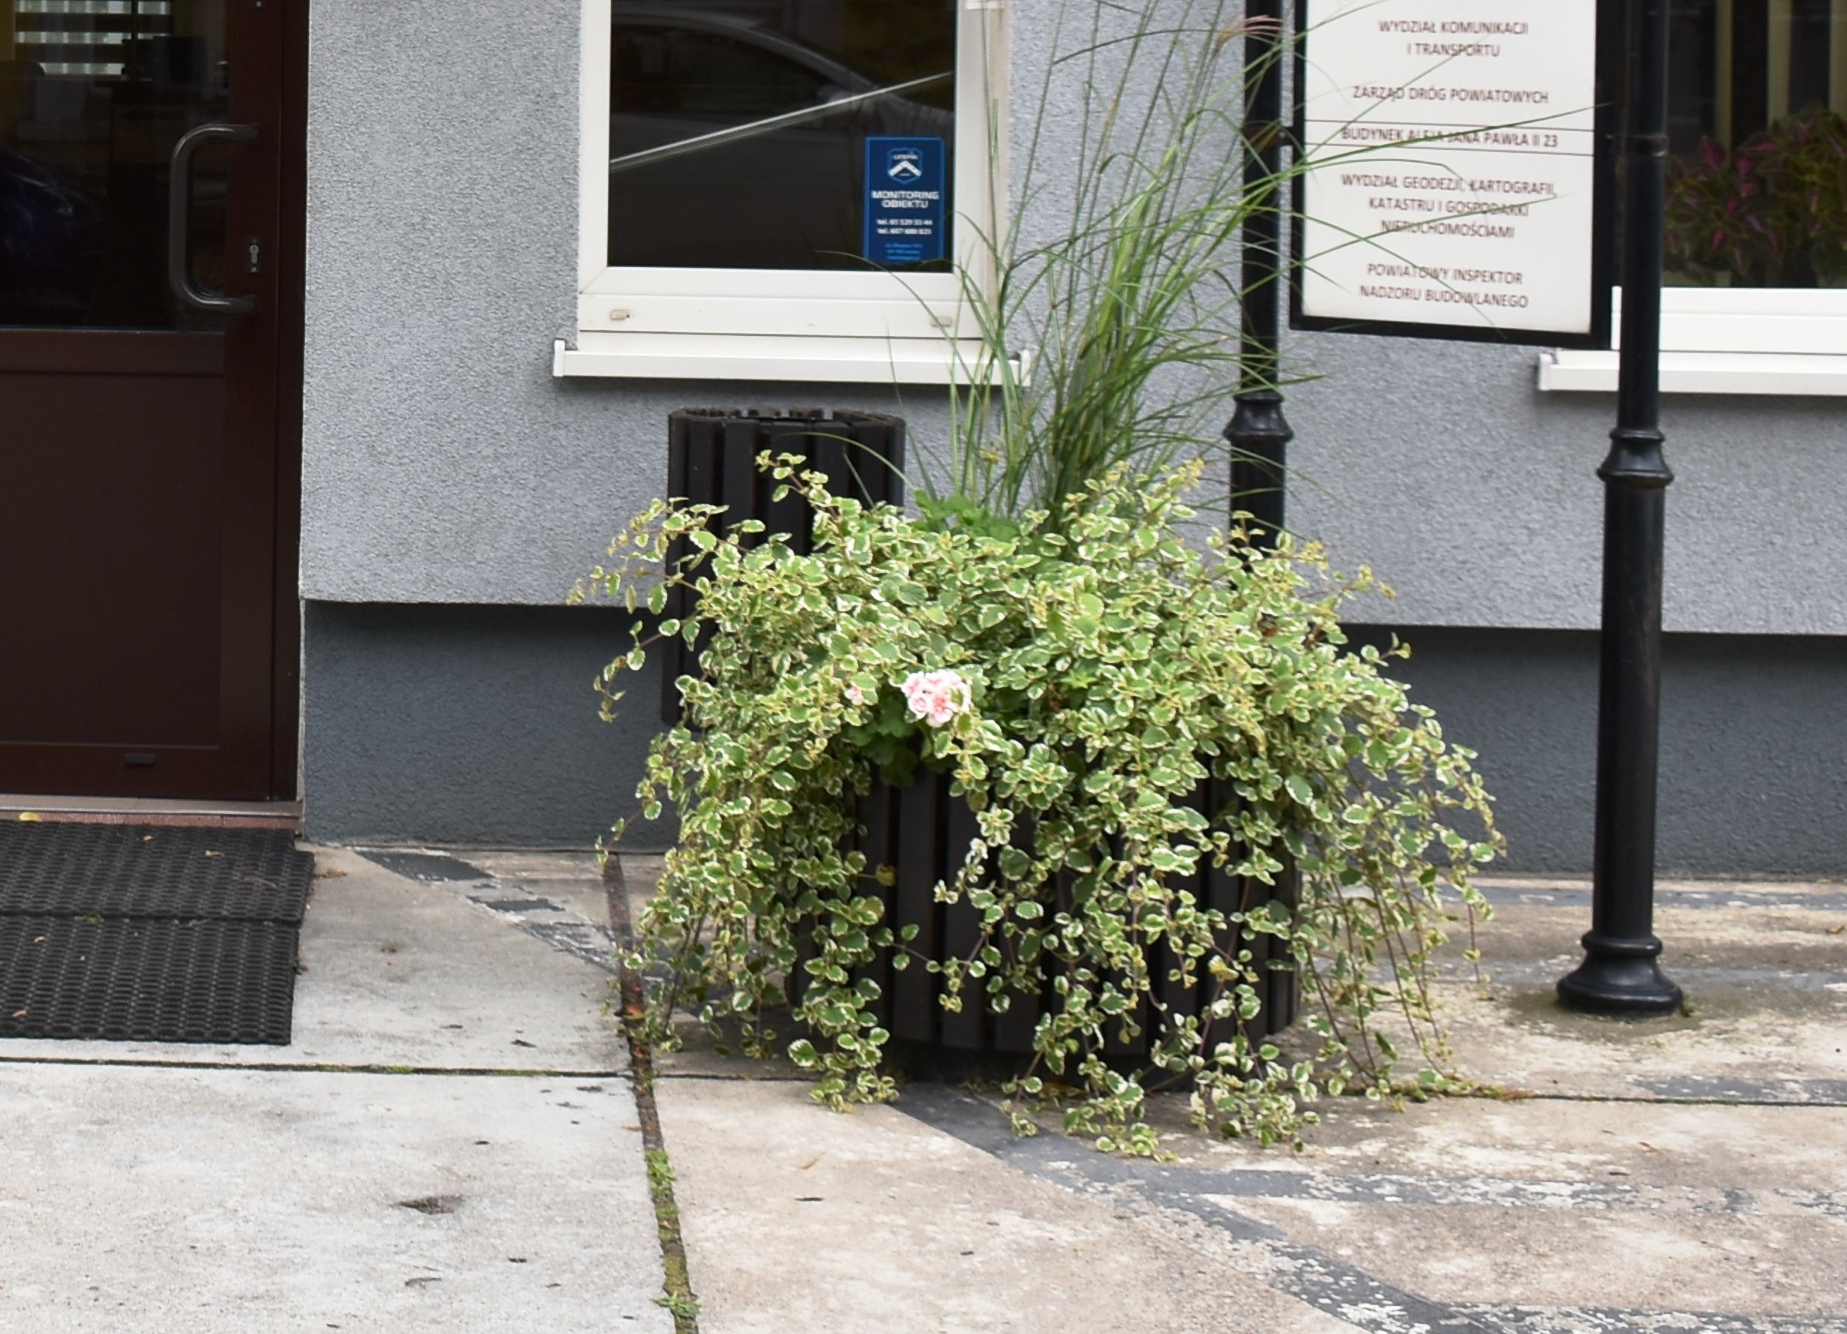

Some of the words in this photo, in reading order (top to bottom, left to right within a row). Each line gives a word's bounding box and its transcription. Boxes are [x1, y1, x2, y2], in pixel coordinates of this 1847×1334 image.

[1379, 20, 1437, 34] WYDZIAŁ
[1441, 21, 1528, 35] KOMUNIKACJI
[1415, 43, 1499, 57] TRANSPORTU
[1353, 86, 1405, 102] ZARZĄD
[1410, 85, 1446, 101] DRÓG
[1450, 88, 1548, 104] POWIATOWYCH
[1342, 127, 1403, 141] BUDYNEK
[1484, 133, 1529, 146] PAWŁA
[1533, 135, 1540, 146] II
[1544, 135, 1558, 147] 23
[1341, 174, 1399, 189] WYDZIAŁ
[1403, 176, 1465, 191] GEODEZJI,
[1469, 178, 1557, 197] KARTOGRAFII,
[871, 191, 939, 200] MONITORING
[881, 200, 928, 208] OBIEKTU
[1369, 197, 1435, 212] KATASTRU
[1445, 201, 1529, 216] GOSPODARKI
[1381, 220, 1515, 239] NIERUCHOMOŚCIAMI
[1367, 263, 1450, 281] POWIATOWY
[1453, 268, 1522, 285] INSPEKTOR
[1360, 285, 1421, 301] NADZORU
[1425, 290, 1528, 308] BUDOWLANEGO
